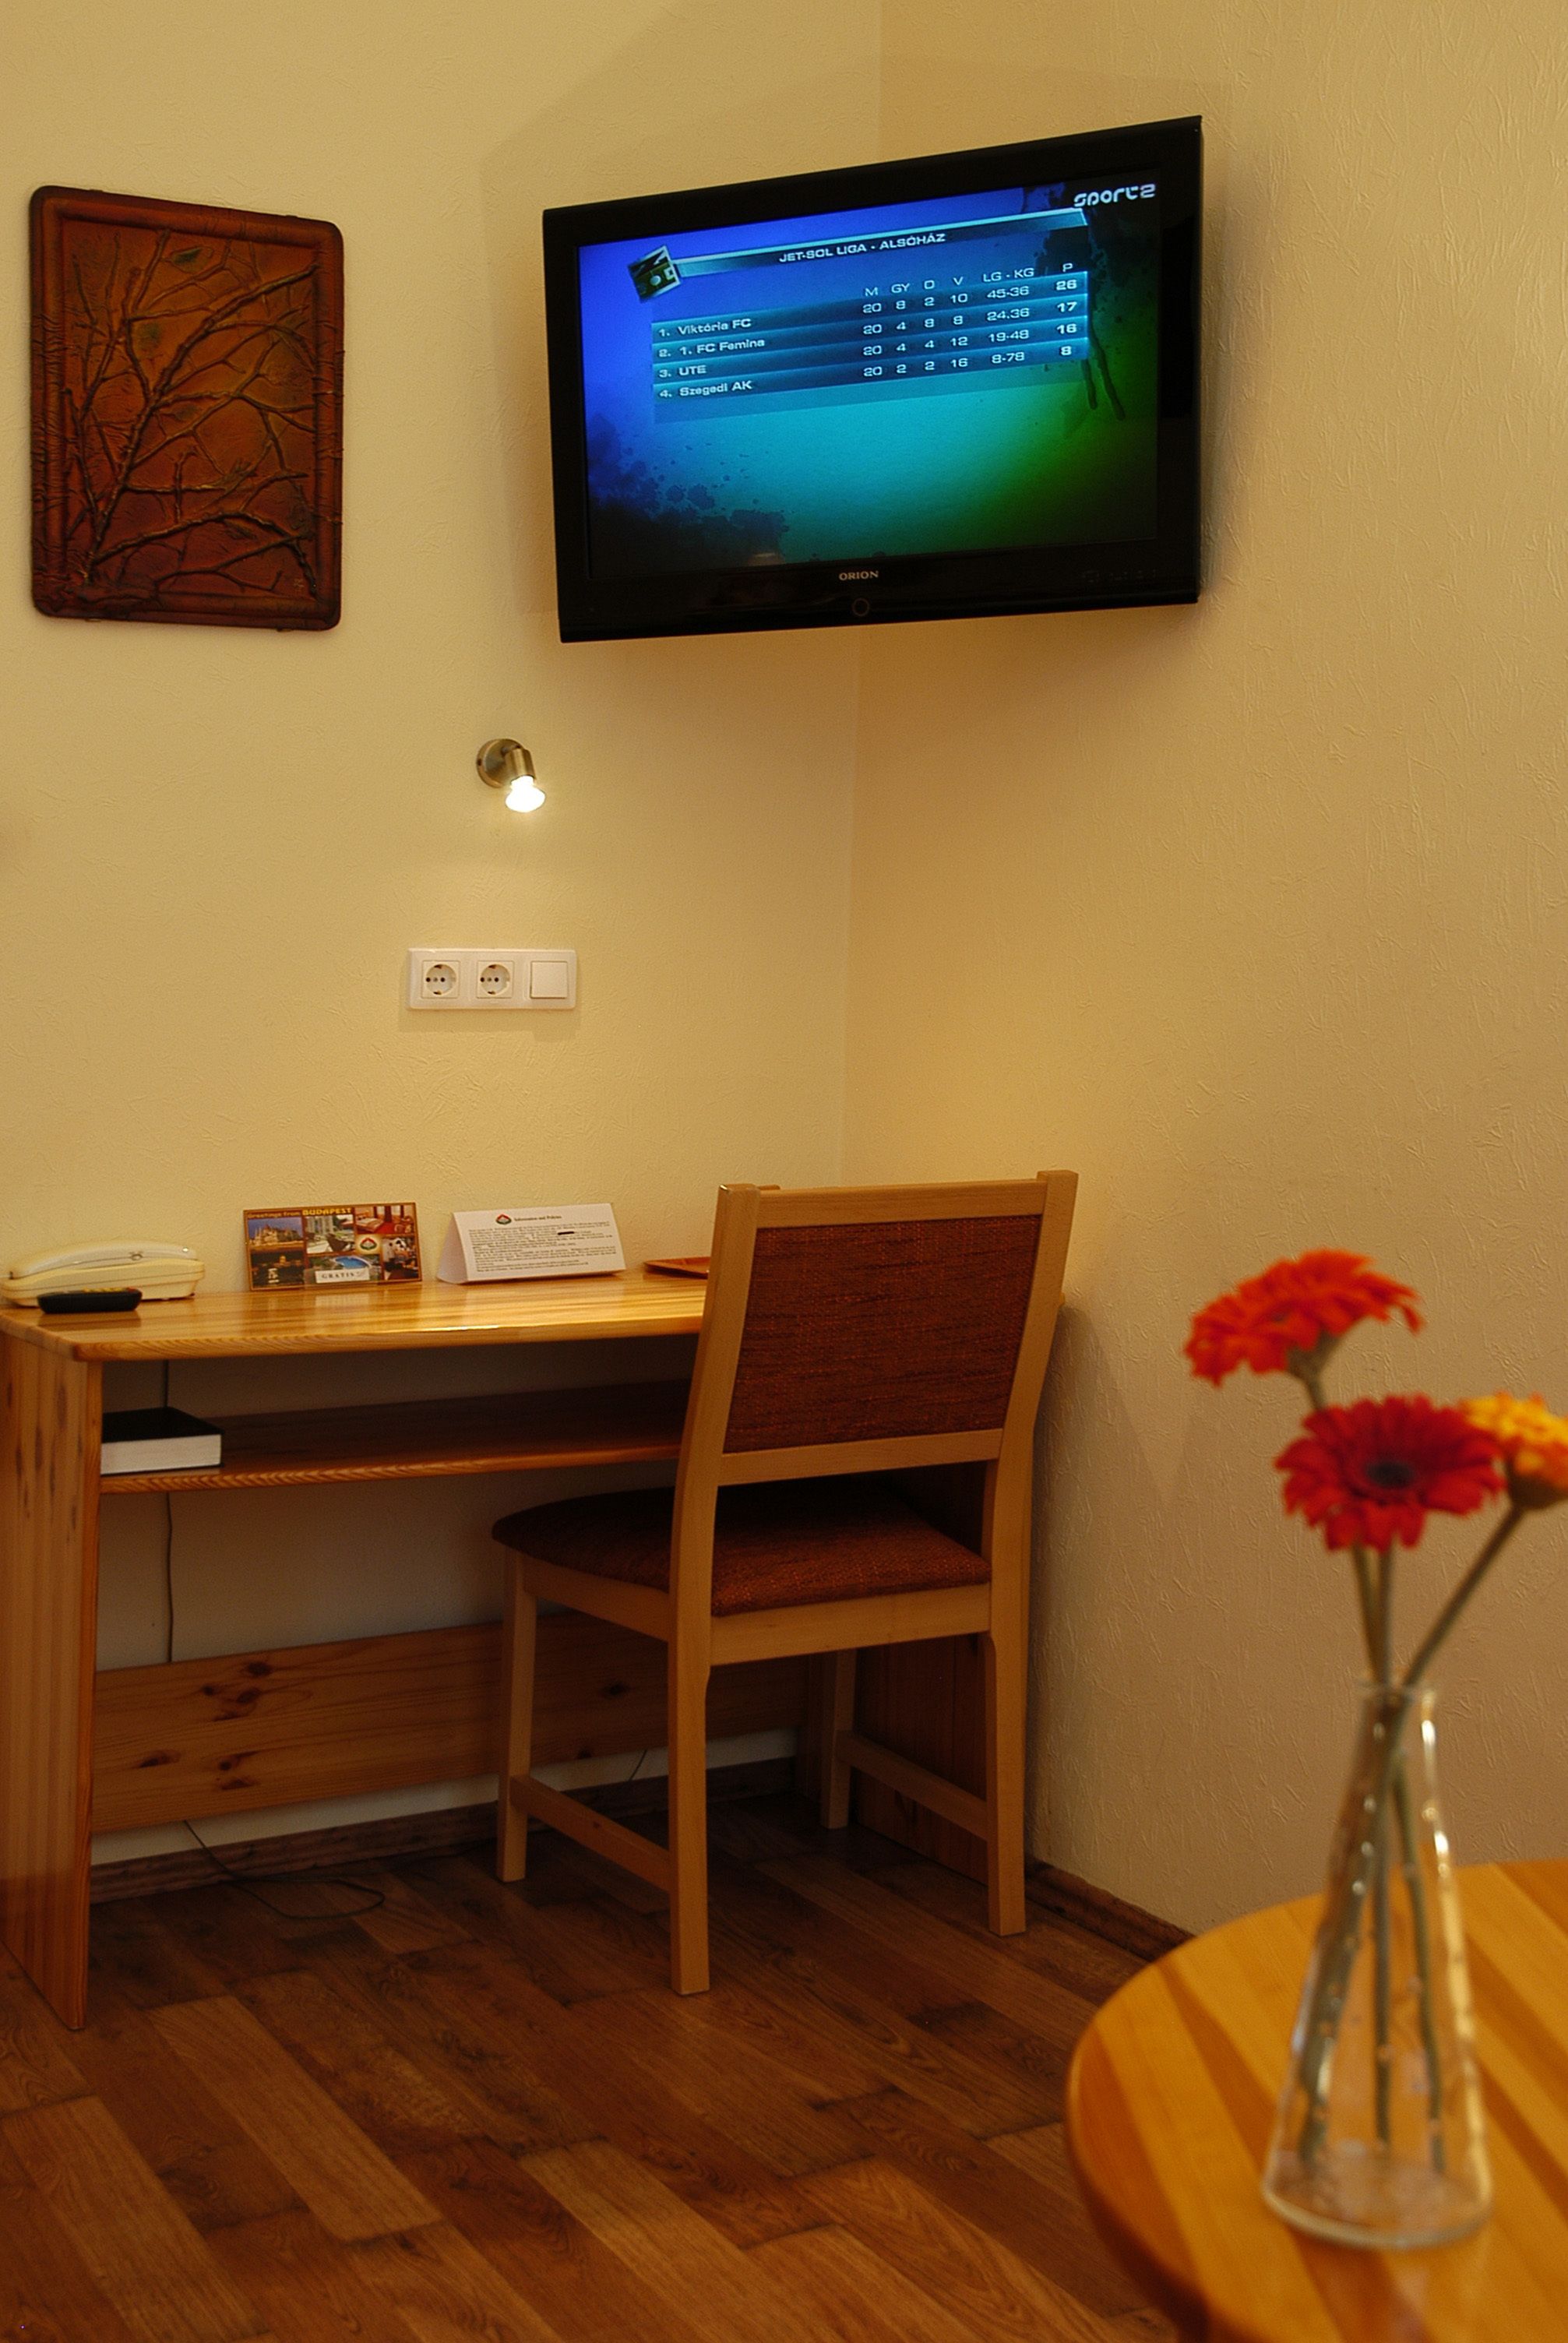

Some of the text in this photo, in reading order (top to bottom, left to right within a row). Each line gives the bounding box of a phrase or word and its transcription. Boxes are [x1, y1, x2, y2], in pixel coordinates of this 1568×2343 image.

[779, 249, 833, 262] JET-SOL
[837, 243, 867, 255] LIGA
[879, 233, 946, 250] ALSÓHÁZ
[865, 287, 879, 296] M
[891, 283, 910, 294] GY
[953, 277, 964, 286] V
[983, 272, 1002, 282] LG
[1014, 267, 1034, 278] KG
[1062, 262, 1073, 273] P
[678, 322, 728, 335] Viktória
[732, 319, 752, 329] FC
[863, 302, 882, 313] 20
[896, 300, 906, 310] 8
[924, 297, 935, 306] 2
[950, 293, 968, 303] 10
[987, 286, 1029, 298] 45-36
[1055, 280, 1077, 291] 26
[658, 349, 671, 358] 2.
[679, 347, 692, 355] 1.
[696, 343, 716, 354] FC
[719, 339, 765, 351] Femina
[863, 324, 882, 335] 20
[896, 322, 906, 330] 4
[925, 318, 935, 328] 8
[953, 315, 964, 325] 8
[1057, 301, 1077, 312] 17
[659, 323, 1077, 378] 3. UTE 20 4 4 12 19-48 16
[679, 382, 728, 396] Szegedi
[731, 380, 752, 391] AK
[863, 366, 883, 377] 20
[897, 364, 907, 373] 2
[925, 361, 935, 371] 2
[950, 358, 968, 368] 16
[992, 352, 1025, 364] 8-78
[1060, 346, 1072, 356] 8
[839, 570, 879, 581] ORION
[302, 1207, 352, 1217] BUDAPEST
